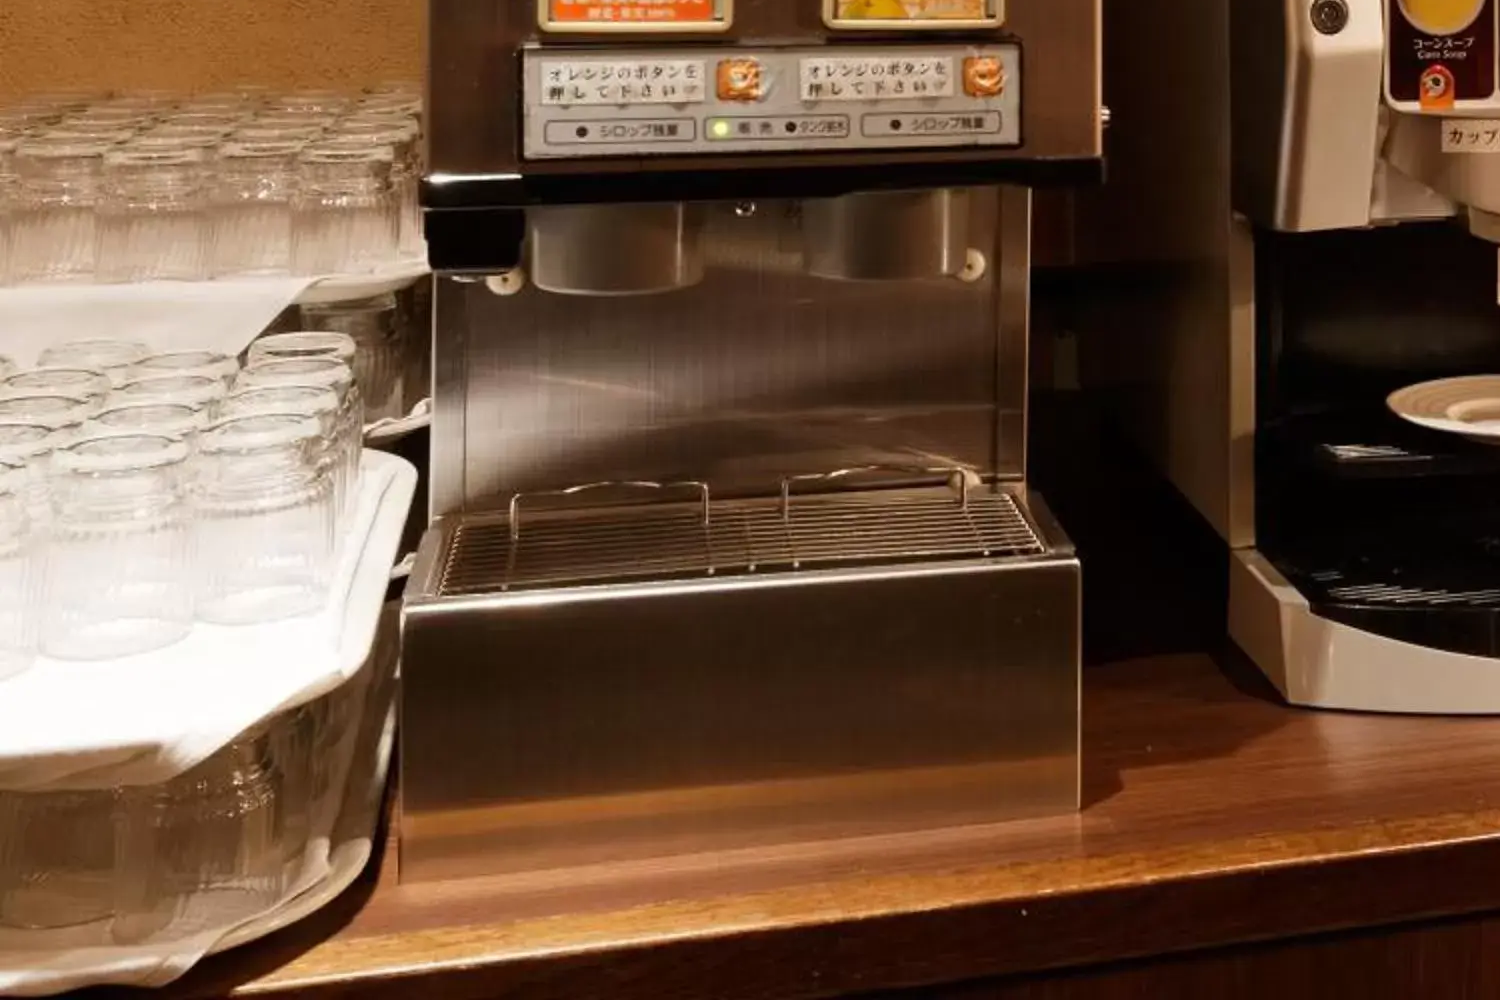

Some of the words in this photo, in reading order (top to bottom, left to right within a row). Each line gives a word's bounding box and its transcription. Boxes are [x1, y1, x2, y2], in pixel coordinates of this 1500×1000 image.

[1413, 36, 1475, 51] コーンスープ
[549, 64, 698, 81] オレンジのボタンを
[808, 60, 947, 79] オレンジのボタンを
